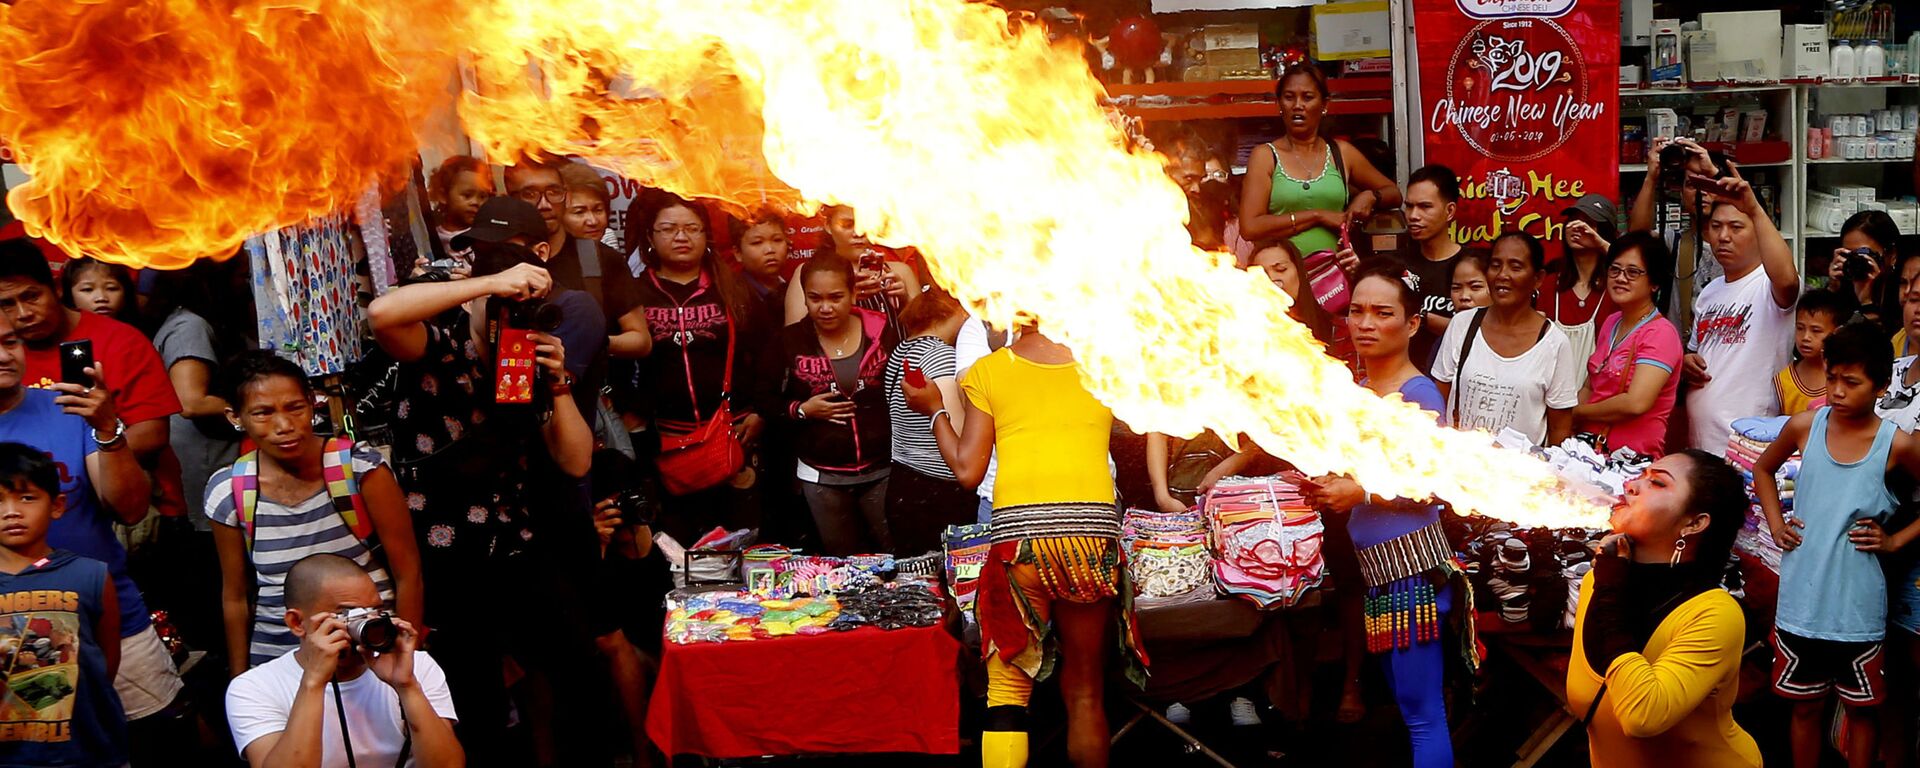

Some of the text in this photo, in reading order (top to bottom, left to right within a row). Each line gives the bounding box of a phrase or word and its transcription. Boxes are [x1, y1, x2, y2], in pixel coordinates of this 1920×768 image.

[1533, 3, 1548, 11] DELI
[1502, 20, 1533, 29] Since 1912
[1491, 50, 1562, 92] 2019
[1431, 94, 1604, 142] Chinese New Year
[1527, 170, 1587, 201] Hee
[645, 303, 721, 322] TRIBAL
[1478, 396, 1497, 411] BE
